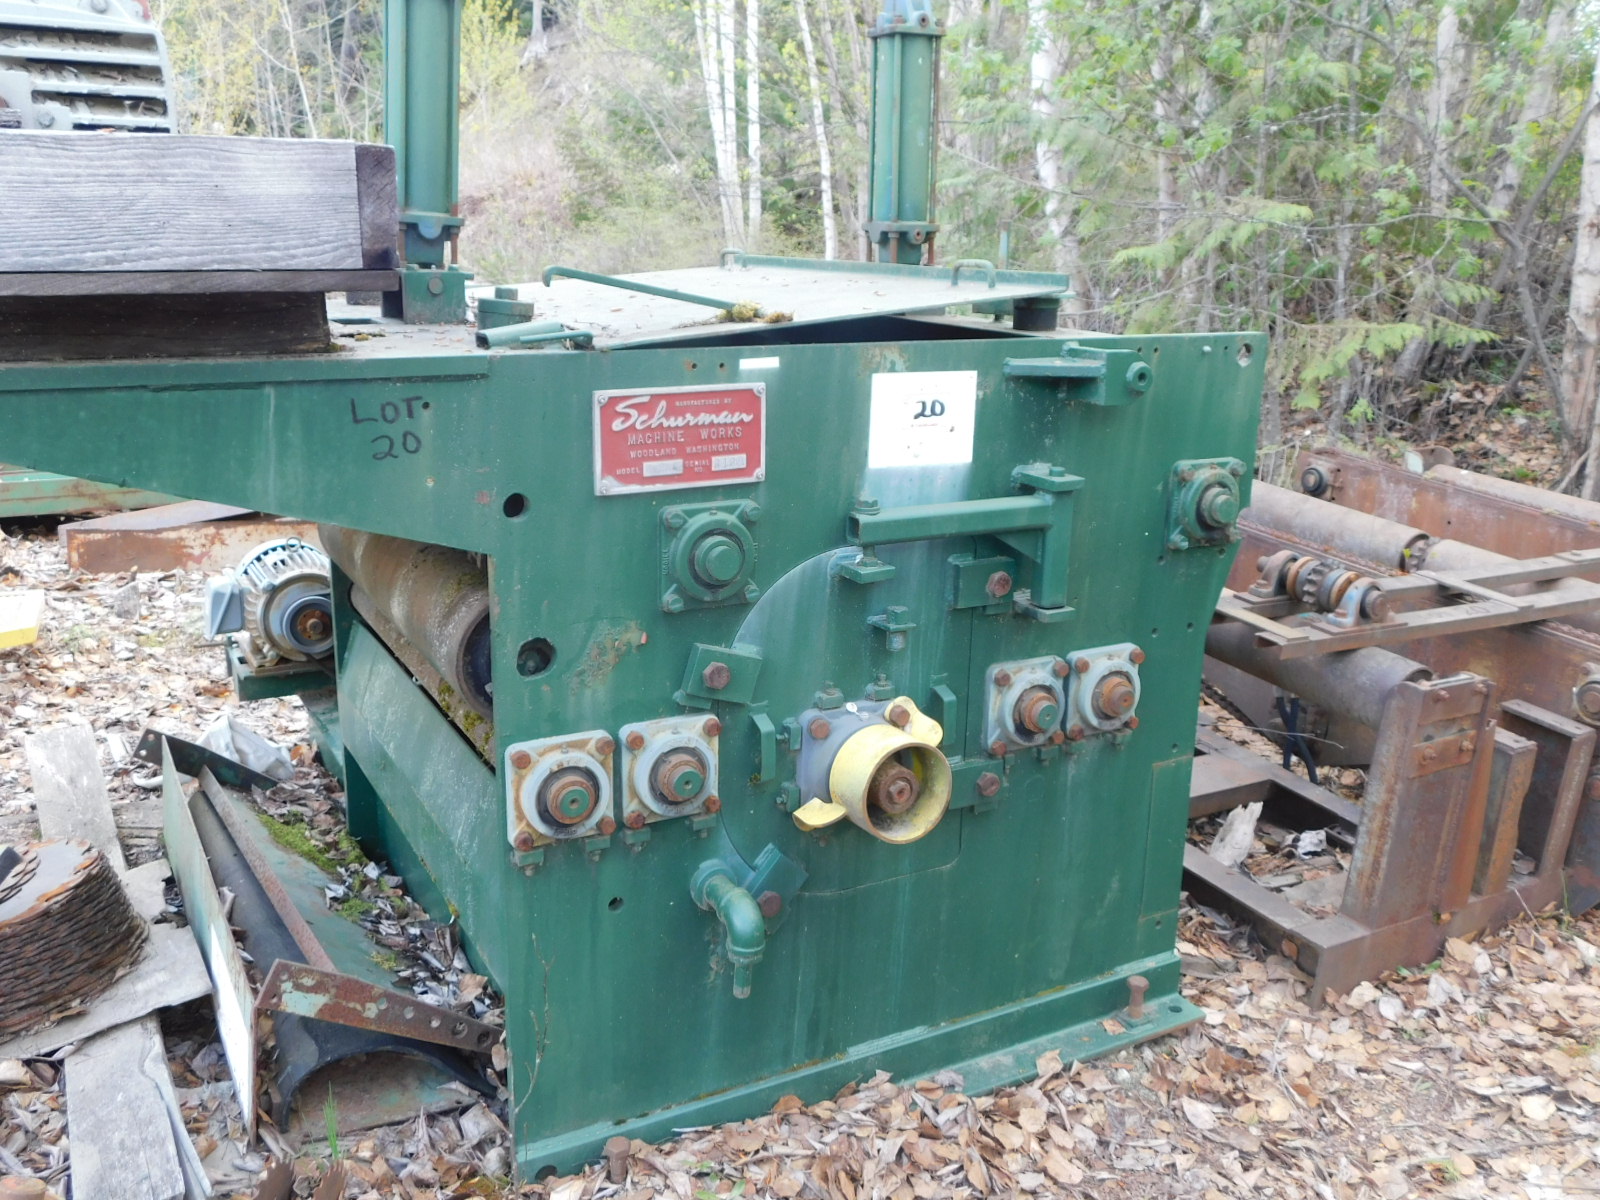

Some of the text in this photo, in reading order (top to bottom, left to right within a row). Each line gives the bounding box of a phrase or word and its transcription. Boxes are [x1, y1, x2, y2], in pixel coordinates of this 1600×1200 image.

[351, 396, 422, 424] LOT
[612, 395, 754, 431] Schurman
[913, 399, 946, 420] 20
[370, 431, 422, 461] 20
[628, 426, 743, 445] MACHINE WORKS
[629, 444, 739, 459] WOODLAND WASHINGTON
